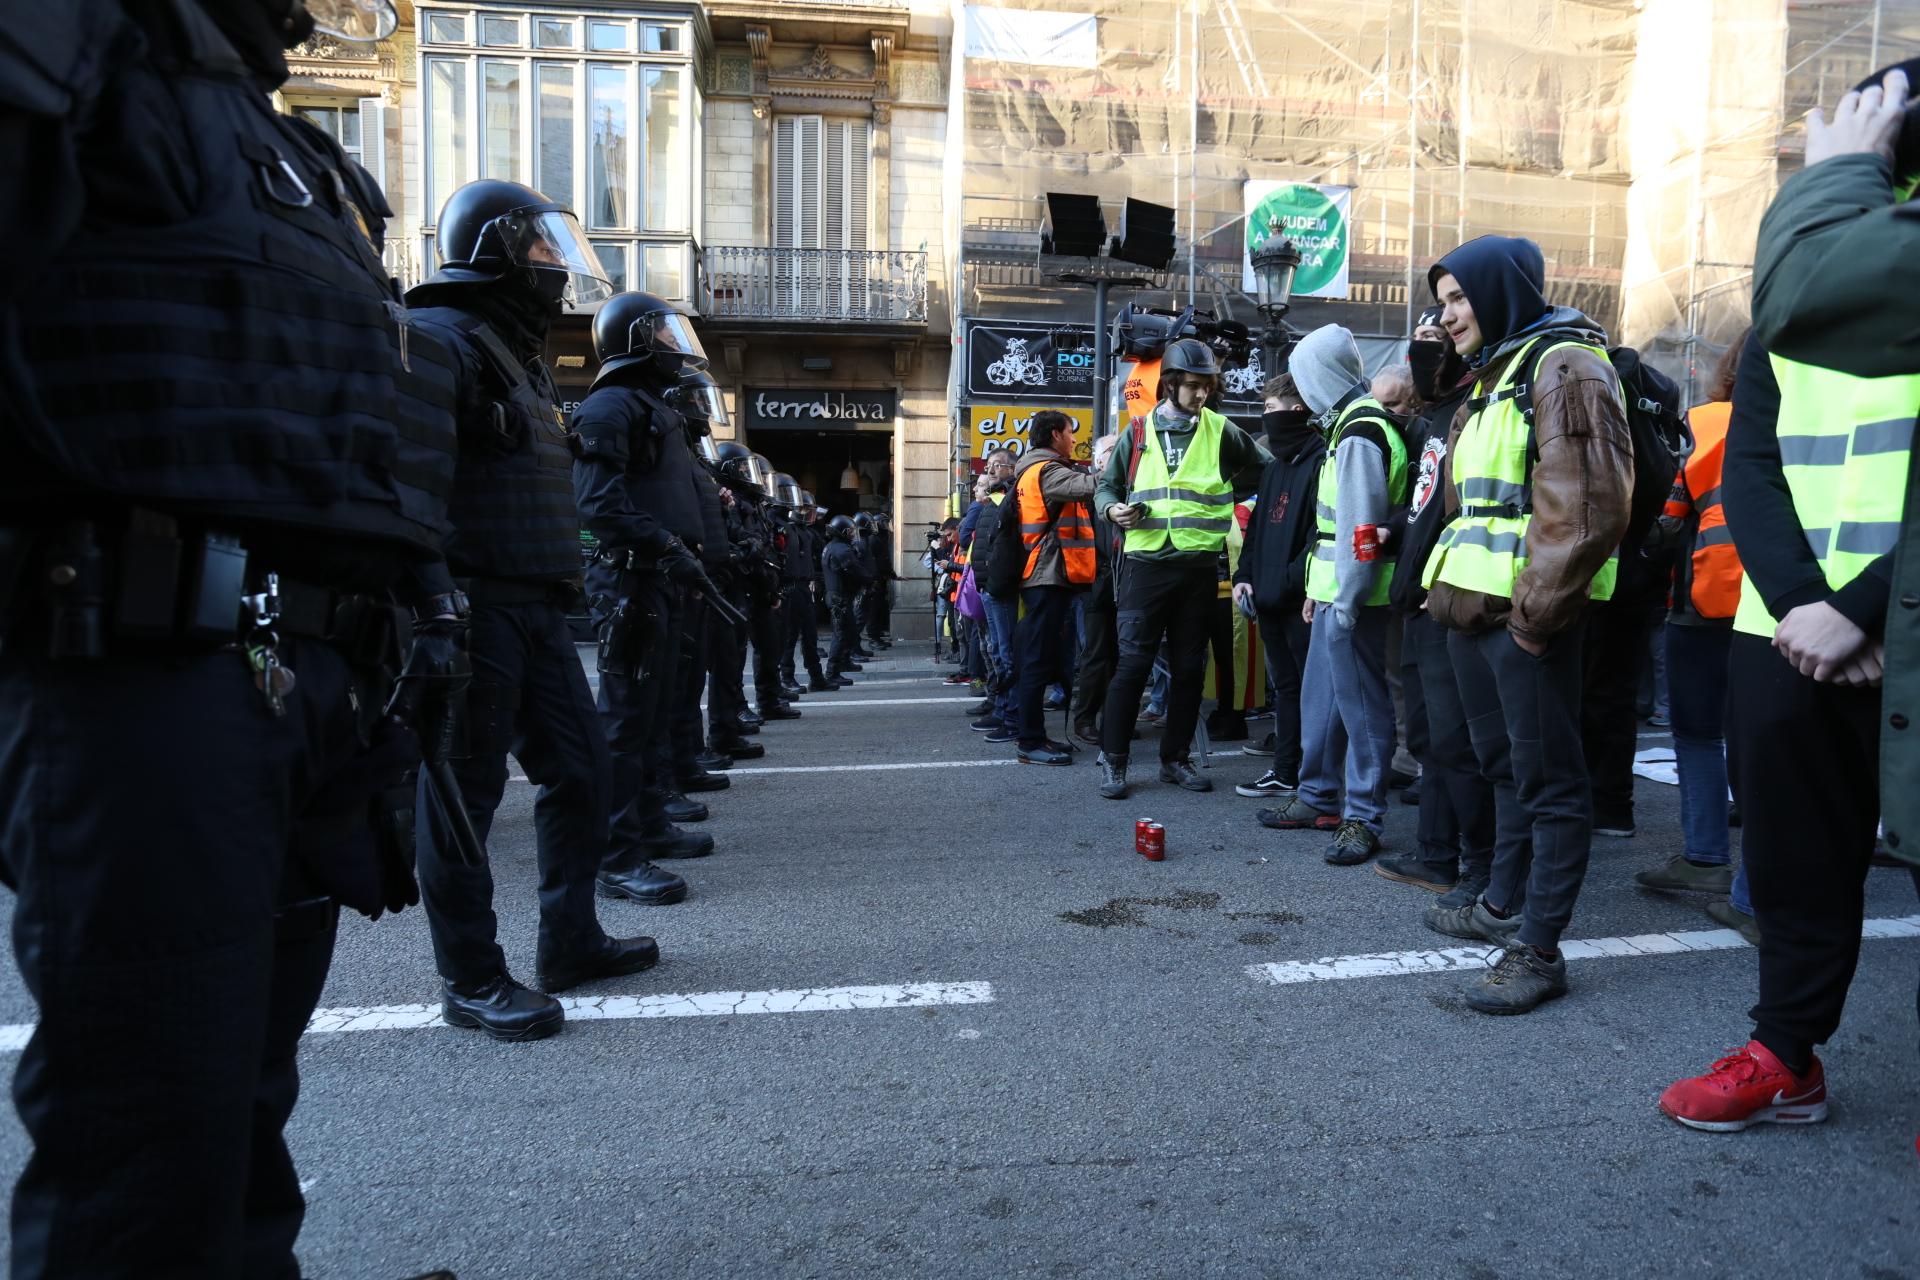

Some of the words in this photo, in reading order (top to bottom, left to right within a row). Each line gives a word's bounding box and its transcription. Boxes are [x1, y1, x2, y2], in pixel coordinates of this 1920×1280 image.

[1281, 233, 1340, 250] ANÇAR
[1057, 368, 1075, 376] NON
[1057, 375, 1087, 383] CUISINE
[756, 393, 885, 419] terrablava
[978, 412, 1006, 434] el
